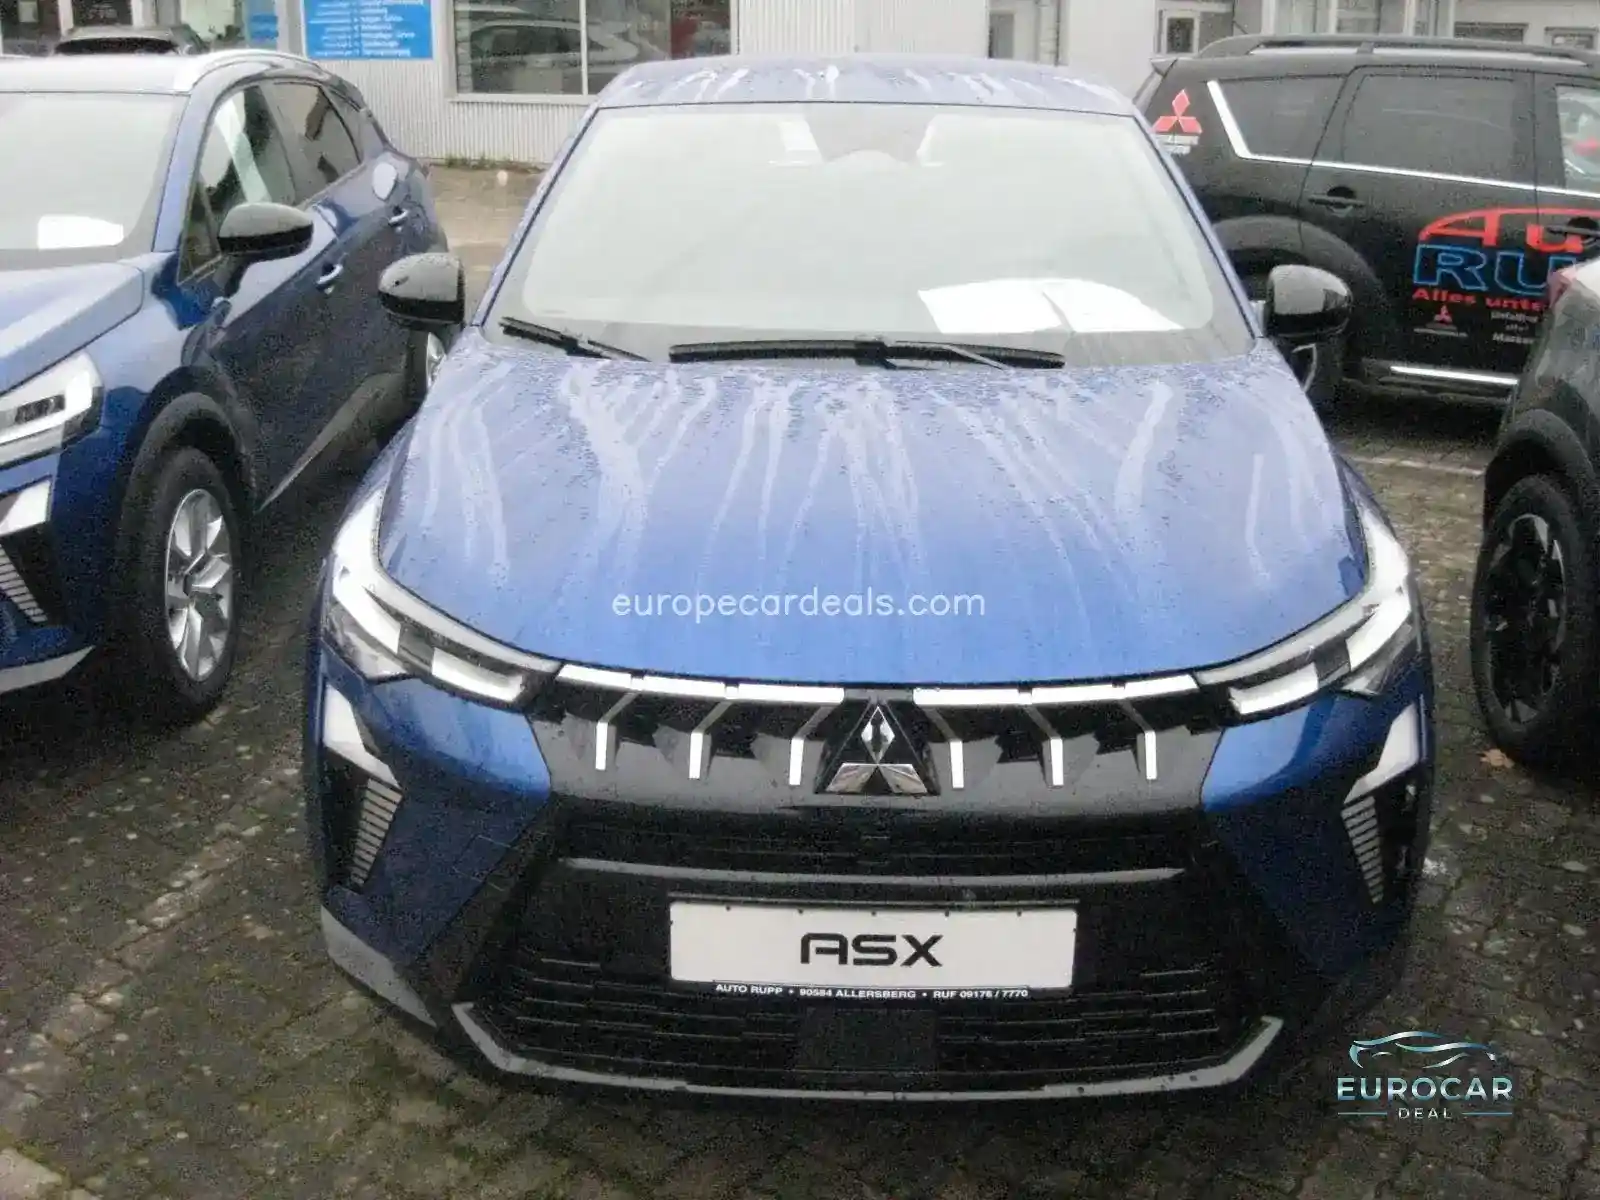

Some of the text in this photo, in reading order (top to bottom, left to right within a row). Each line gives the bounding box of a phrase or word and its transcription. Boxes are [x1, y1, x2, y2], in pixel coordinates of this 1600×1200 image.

[1412, 287, 1548, 312] Alles unte
[799, 932, 944, 967] ASX
[715, 983, 748, 993] AUTO
[750, 985, 783, 995] RUPP
[835, 988, 916, 999] ALLERSBERG
[933, 989, 957, 999] RUF
